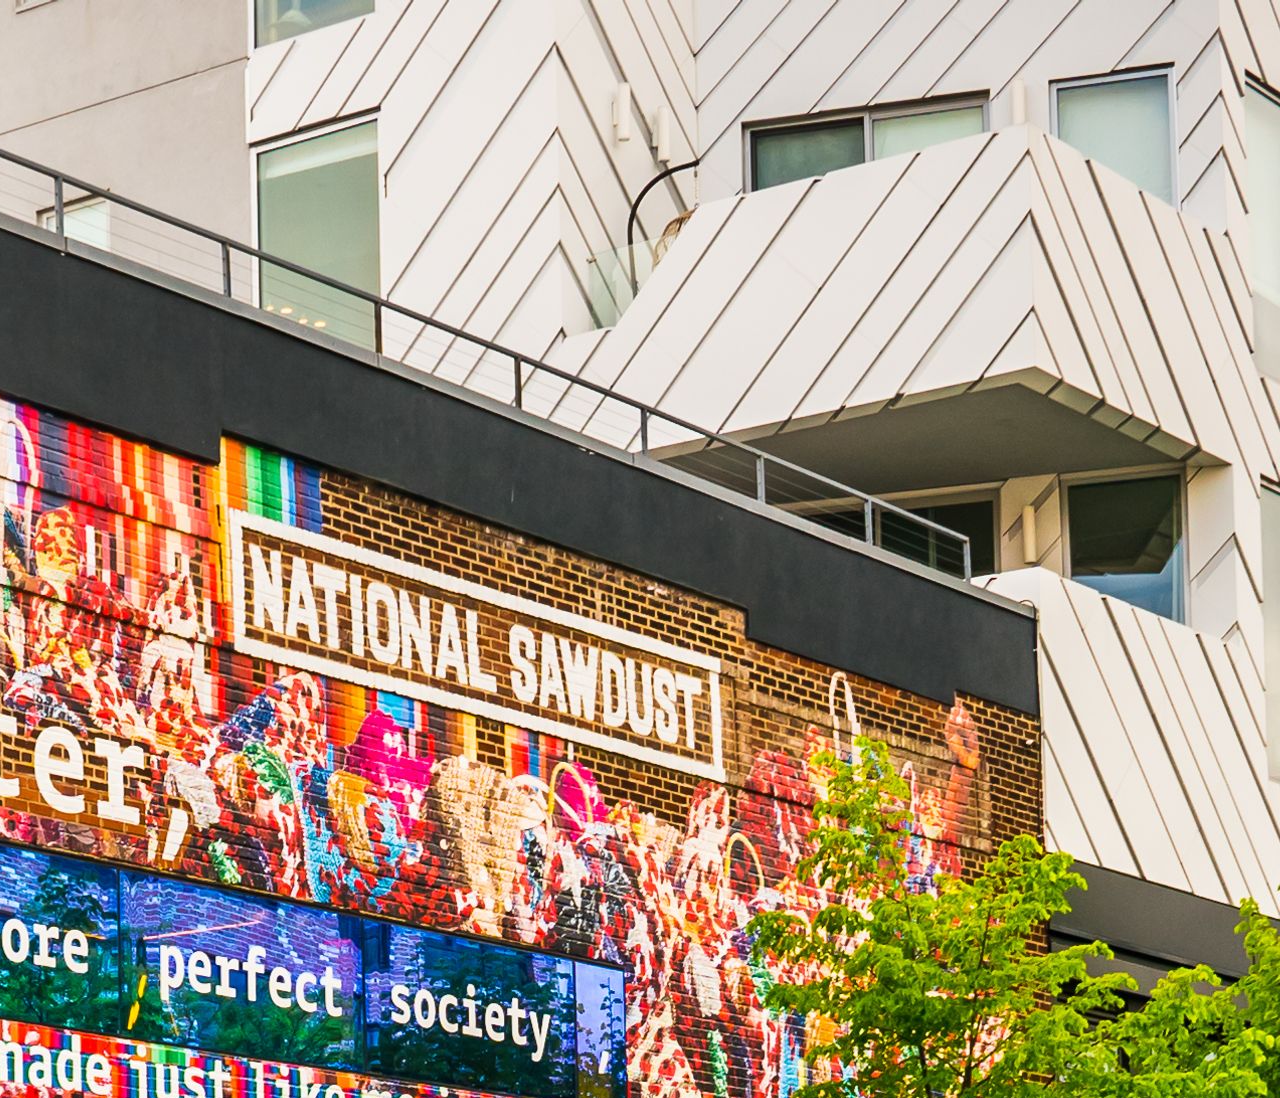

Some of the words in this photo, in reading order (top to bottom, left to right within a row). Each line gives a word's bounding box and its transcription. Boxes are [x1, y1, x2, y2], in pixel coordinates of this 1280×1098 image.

[249, 542, 497, 693] NATIONAL
[509, 624, 702, 750] SAWDUST
[159, 942, 343, 1017] perfect
